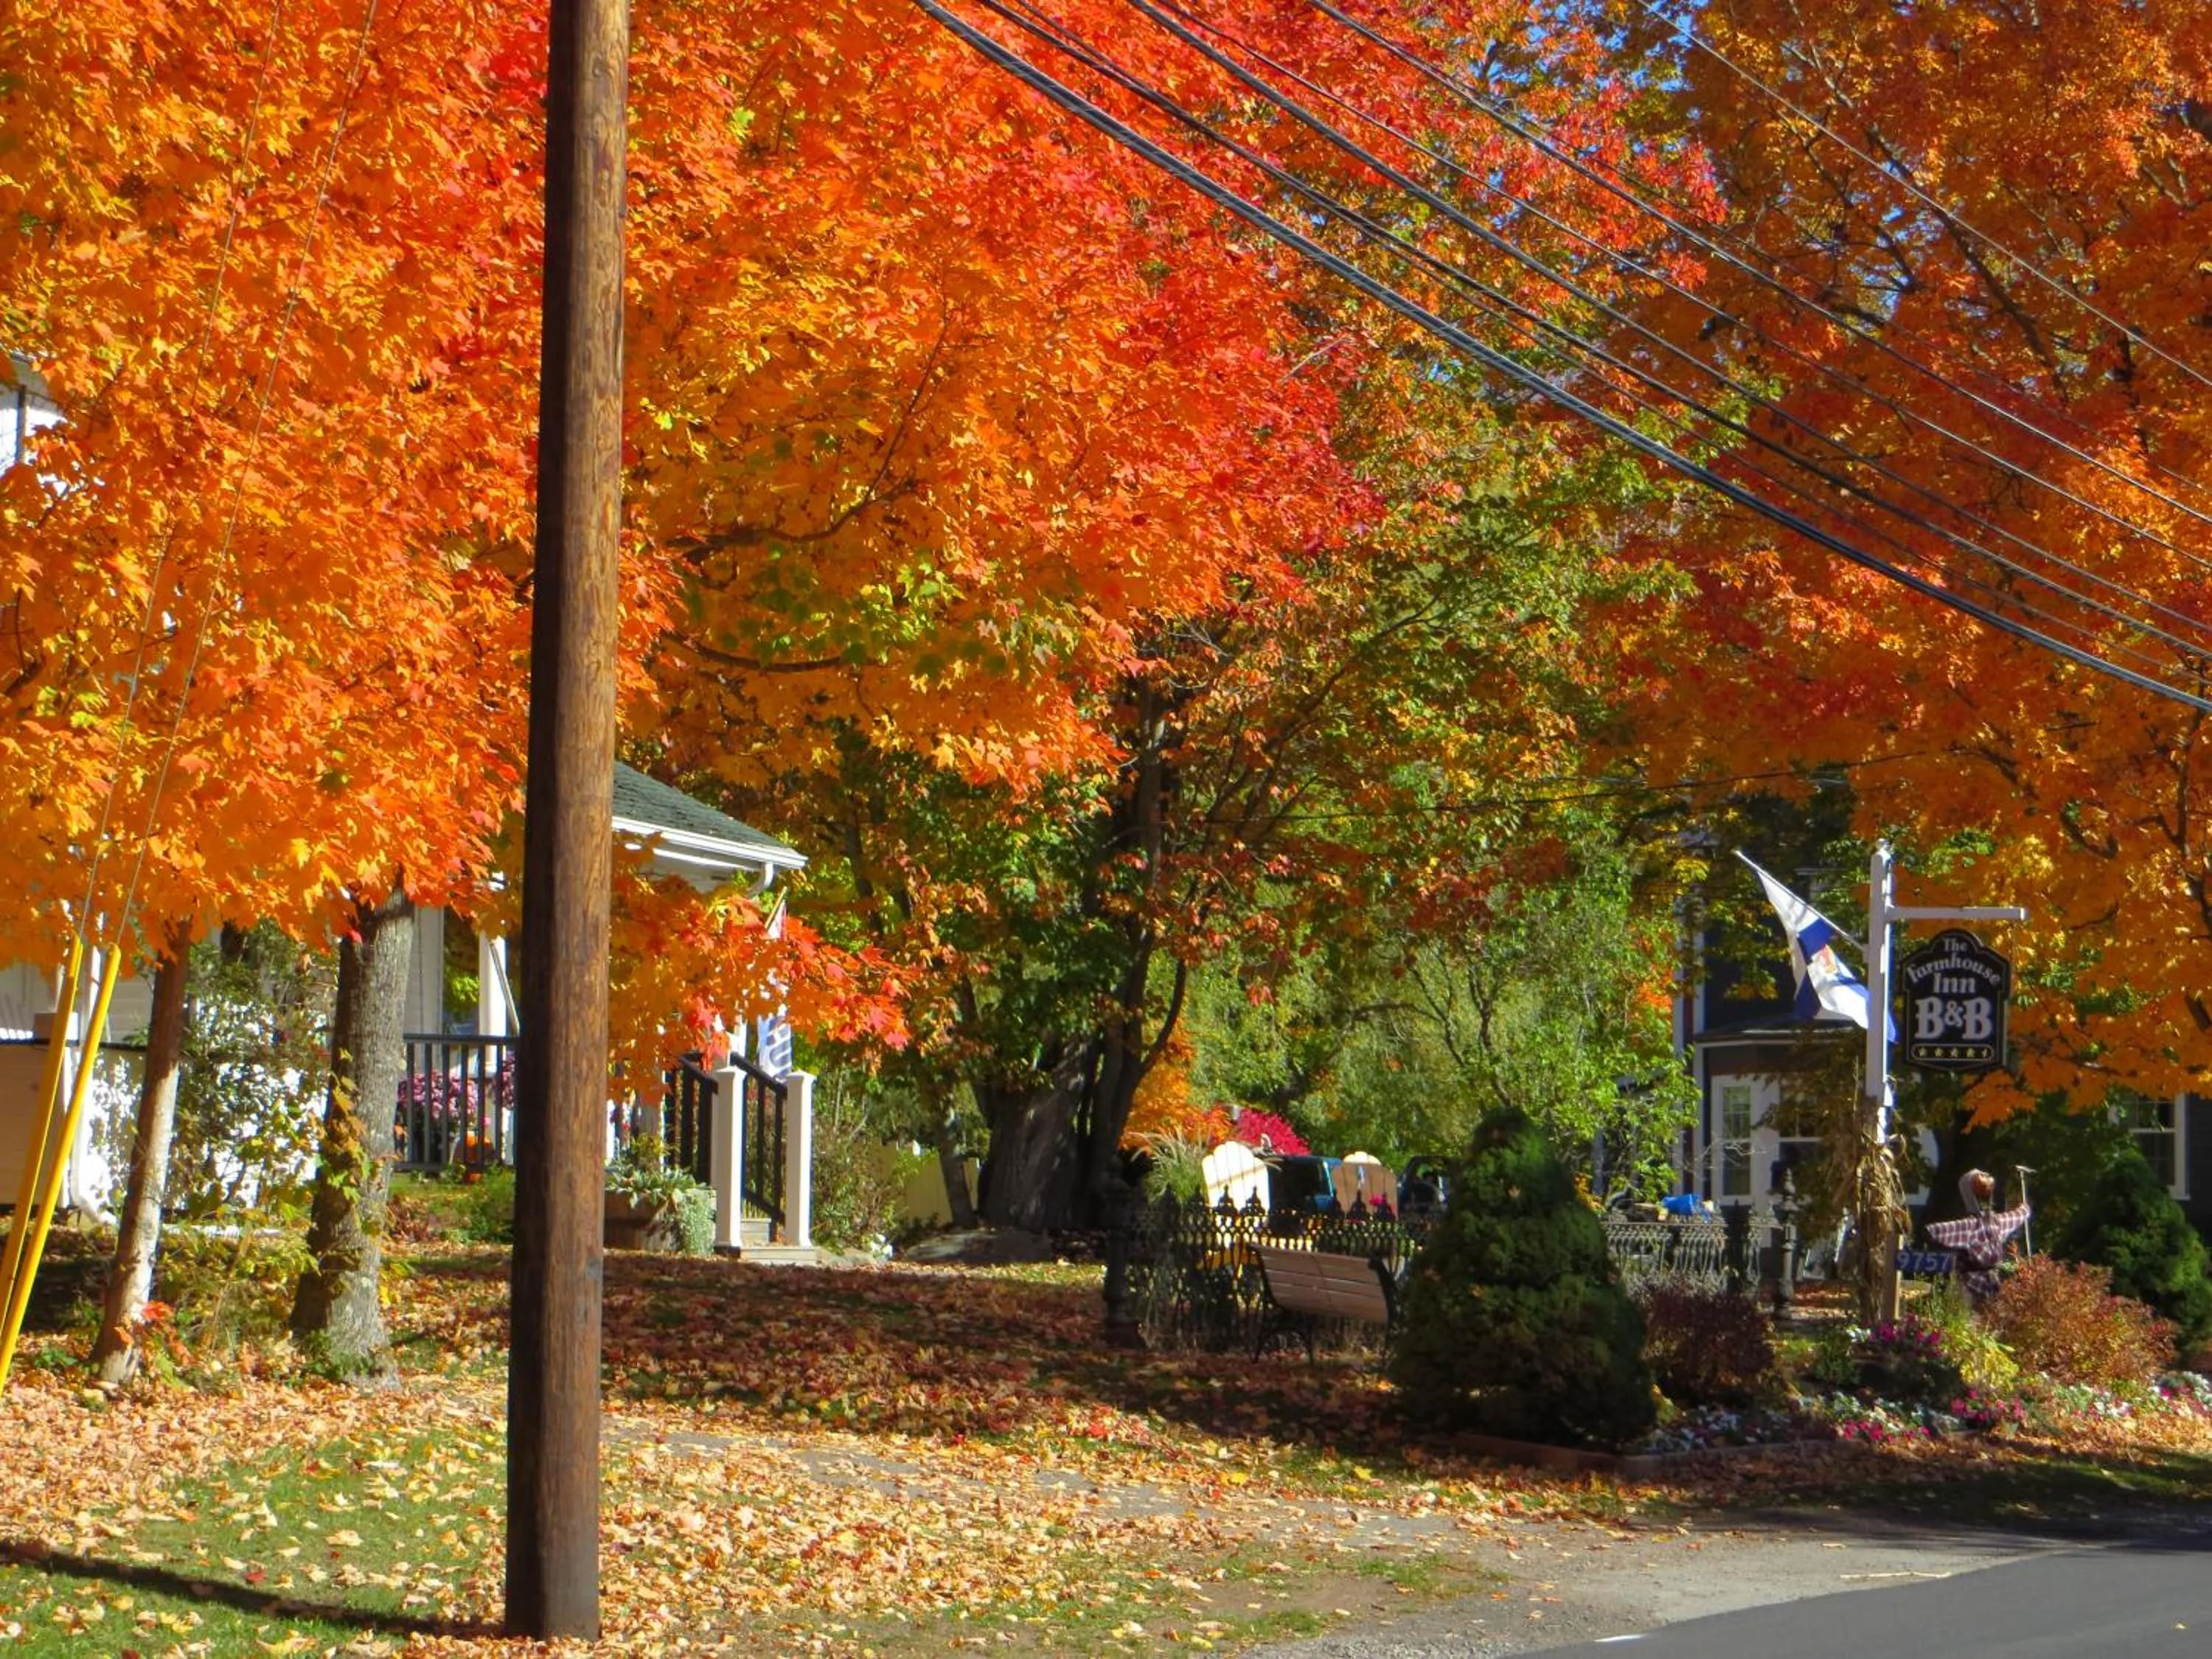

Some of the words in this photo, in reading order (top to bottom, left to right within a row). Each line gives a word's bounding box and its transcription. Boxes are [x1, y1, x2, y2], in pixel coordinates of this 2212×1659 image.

[1943, 939, 1968, 952] The
[1907, 953, 2000, 984] Farmhouse
[1933, 973, 1976, 993] Inn
[1915, 997, 1992, 1040] B&B
[1897, 1251, 1950, 1271] 9757
